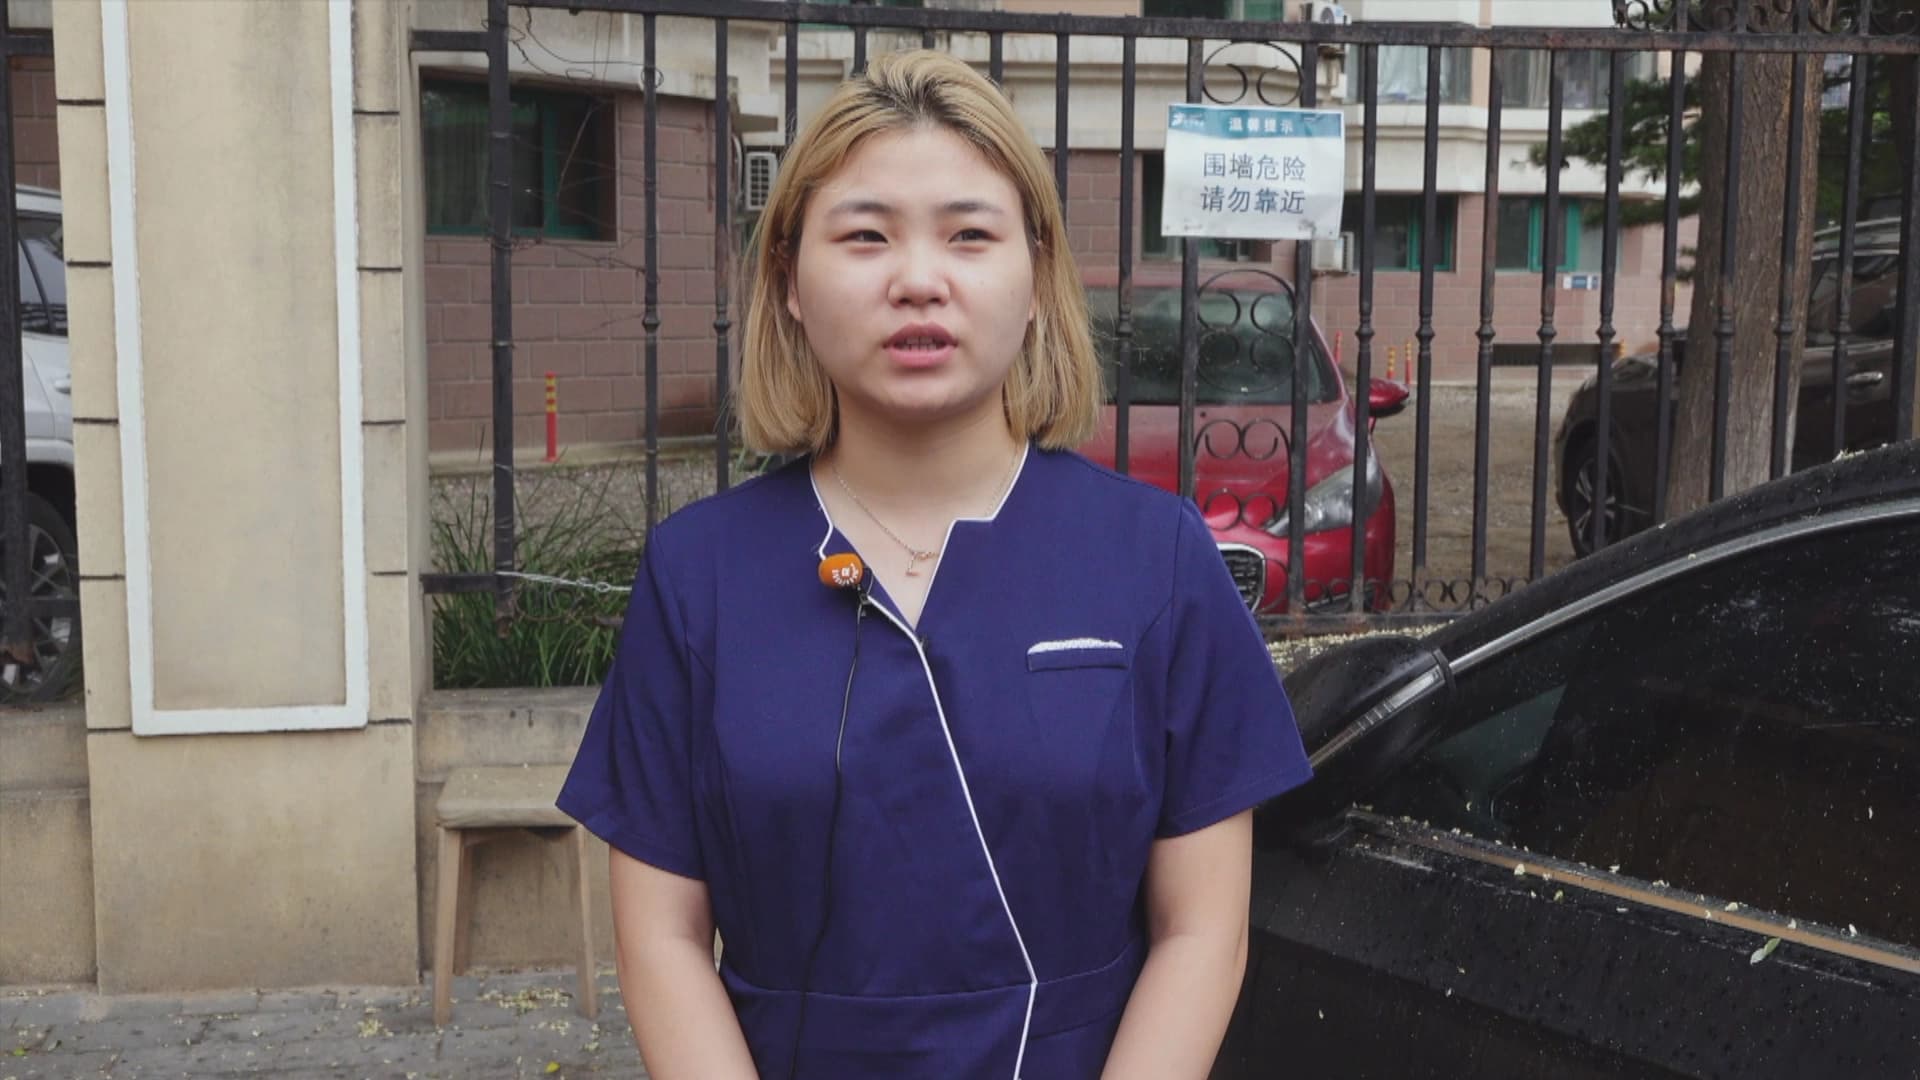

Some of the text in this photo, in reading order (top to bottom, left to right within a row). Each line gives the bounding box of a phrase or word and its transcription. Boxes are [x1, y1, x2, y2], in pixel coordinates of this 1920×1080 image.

[1203, 152, 1306, 182] 围墙危险
[1200, 185, 1306, 214] 请勿靠近
